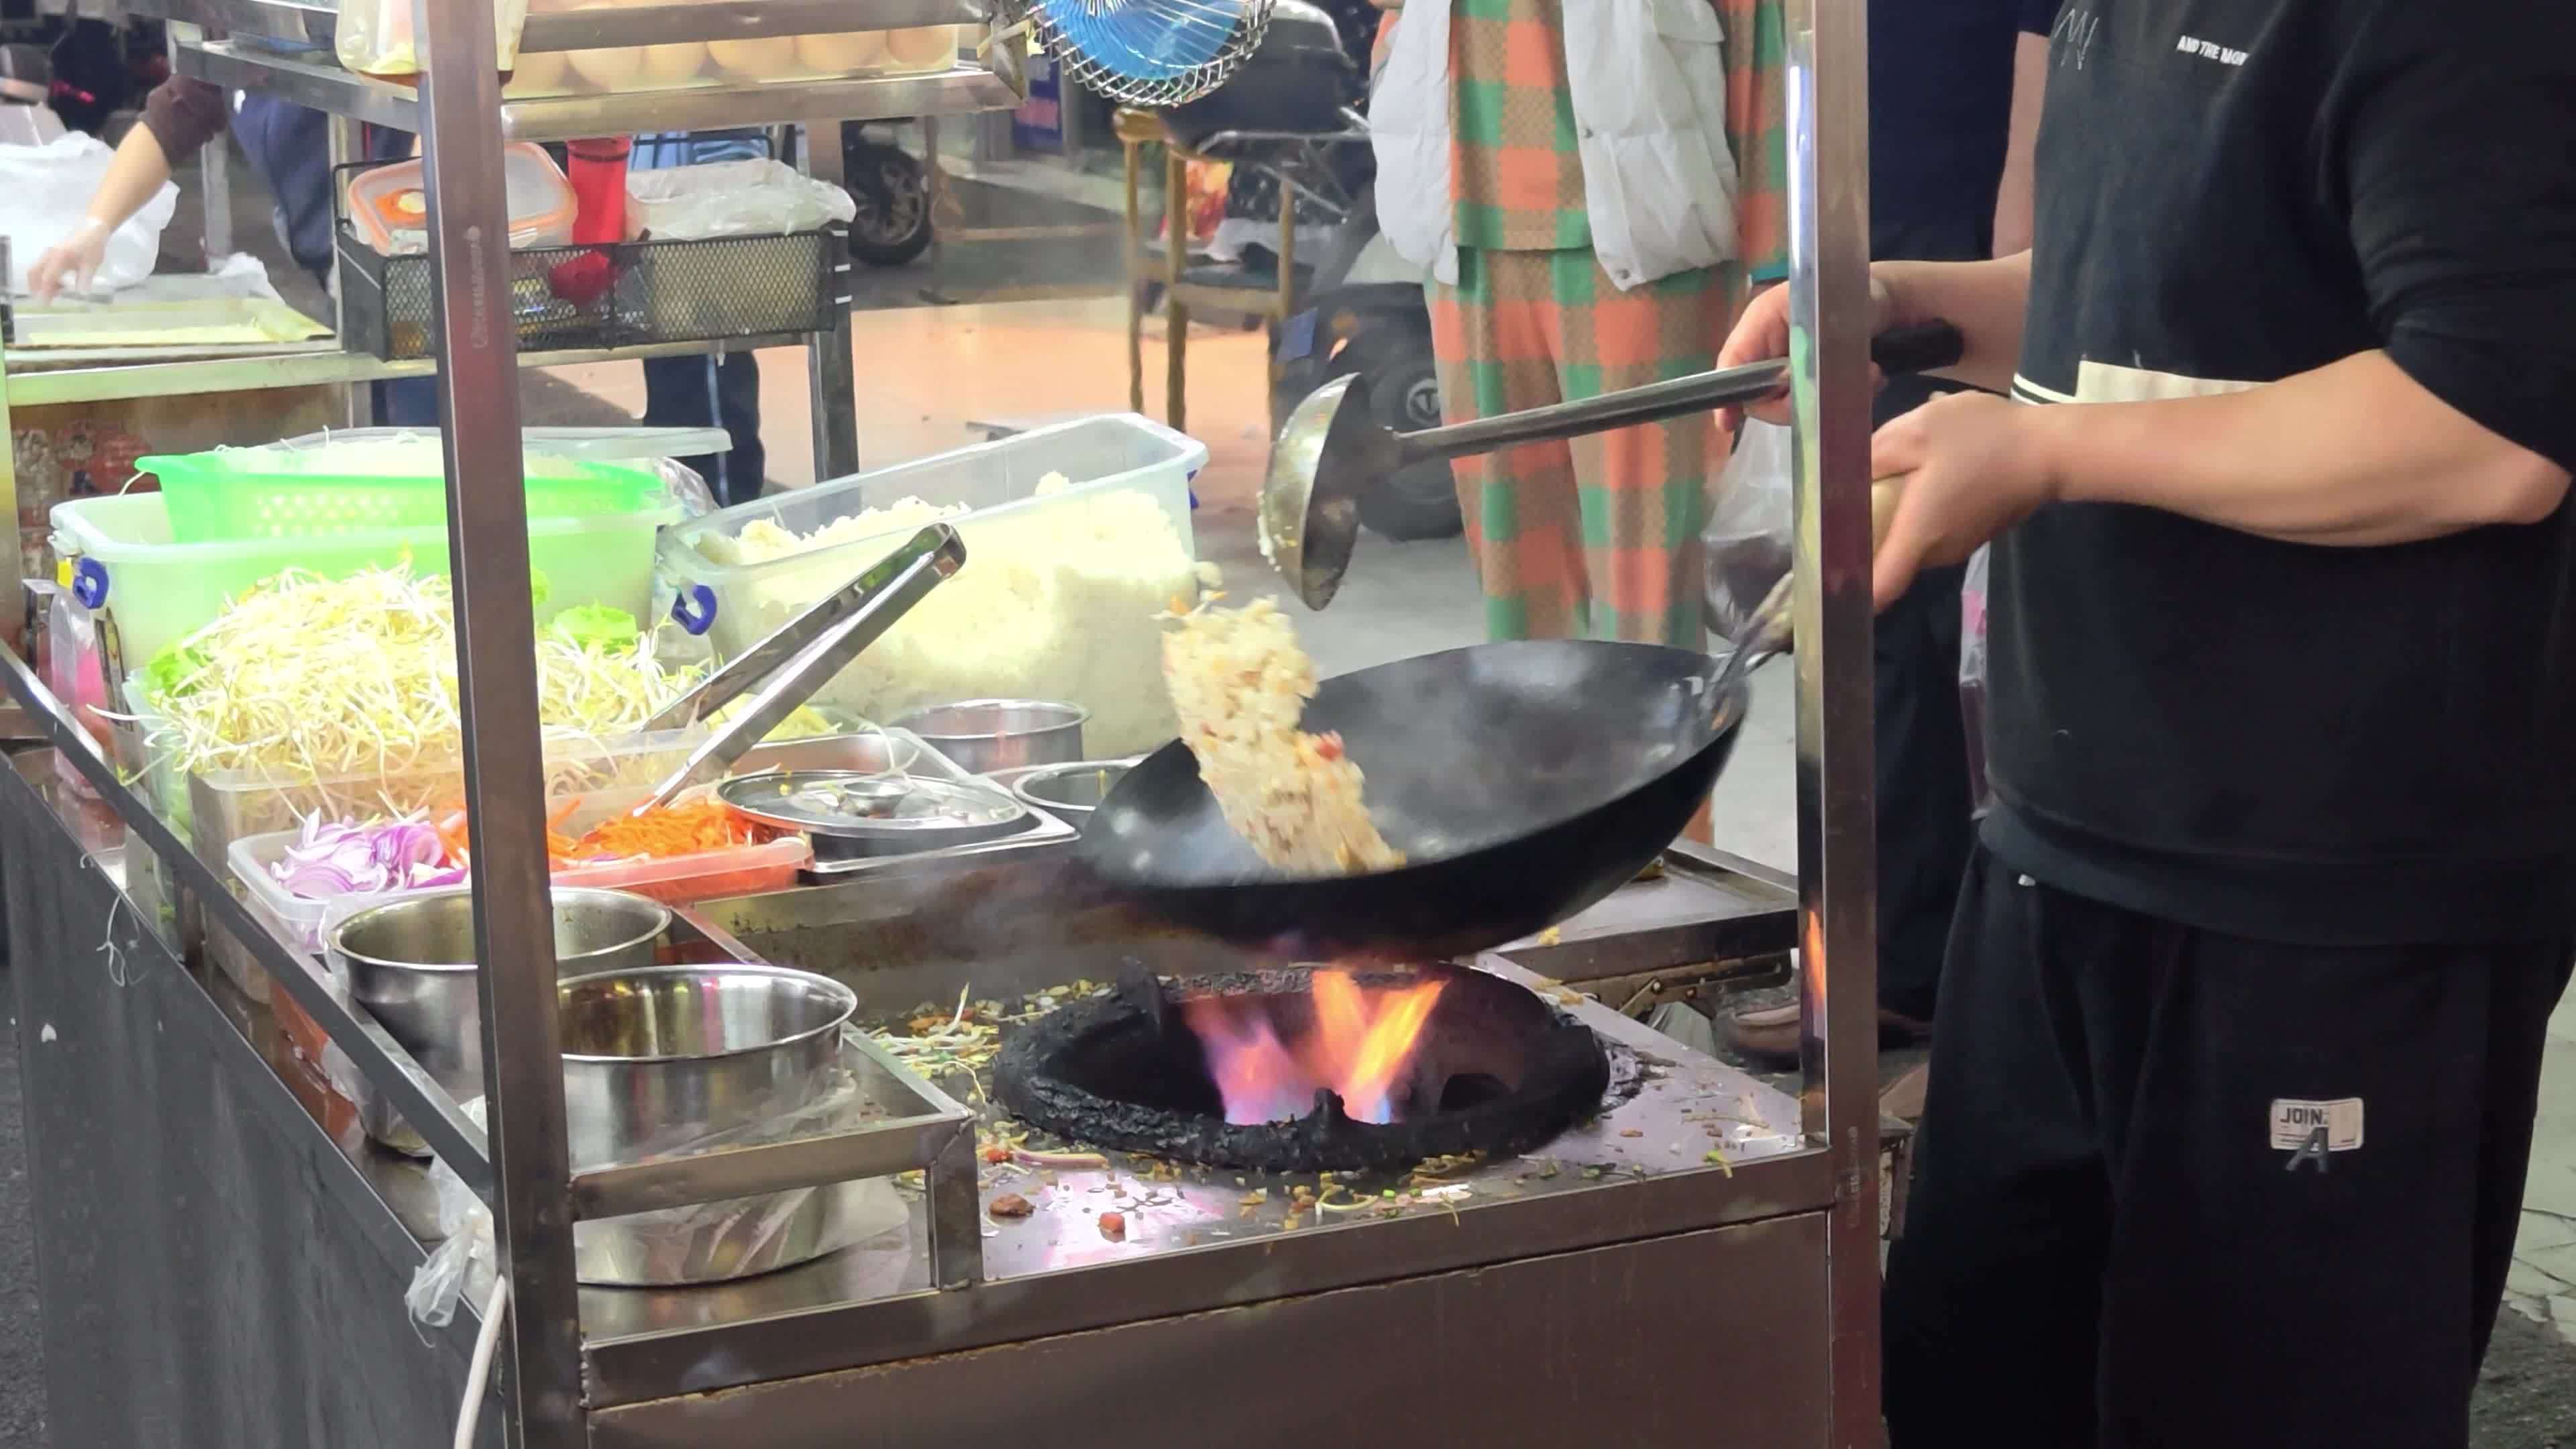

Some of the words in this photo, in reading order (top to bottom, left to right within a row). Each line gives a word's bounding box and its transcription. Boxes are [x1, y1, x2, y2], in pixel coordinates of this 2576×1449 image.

[2176, 35, 2200, 53] AND
[2198, 40, 2220, 60] THE
[2286, 1126, 2329, 1172] A
